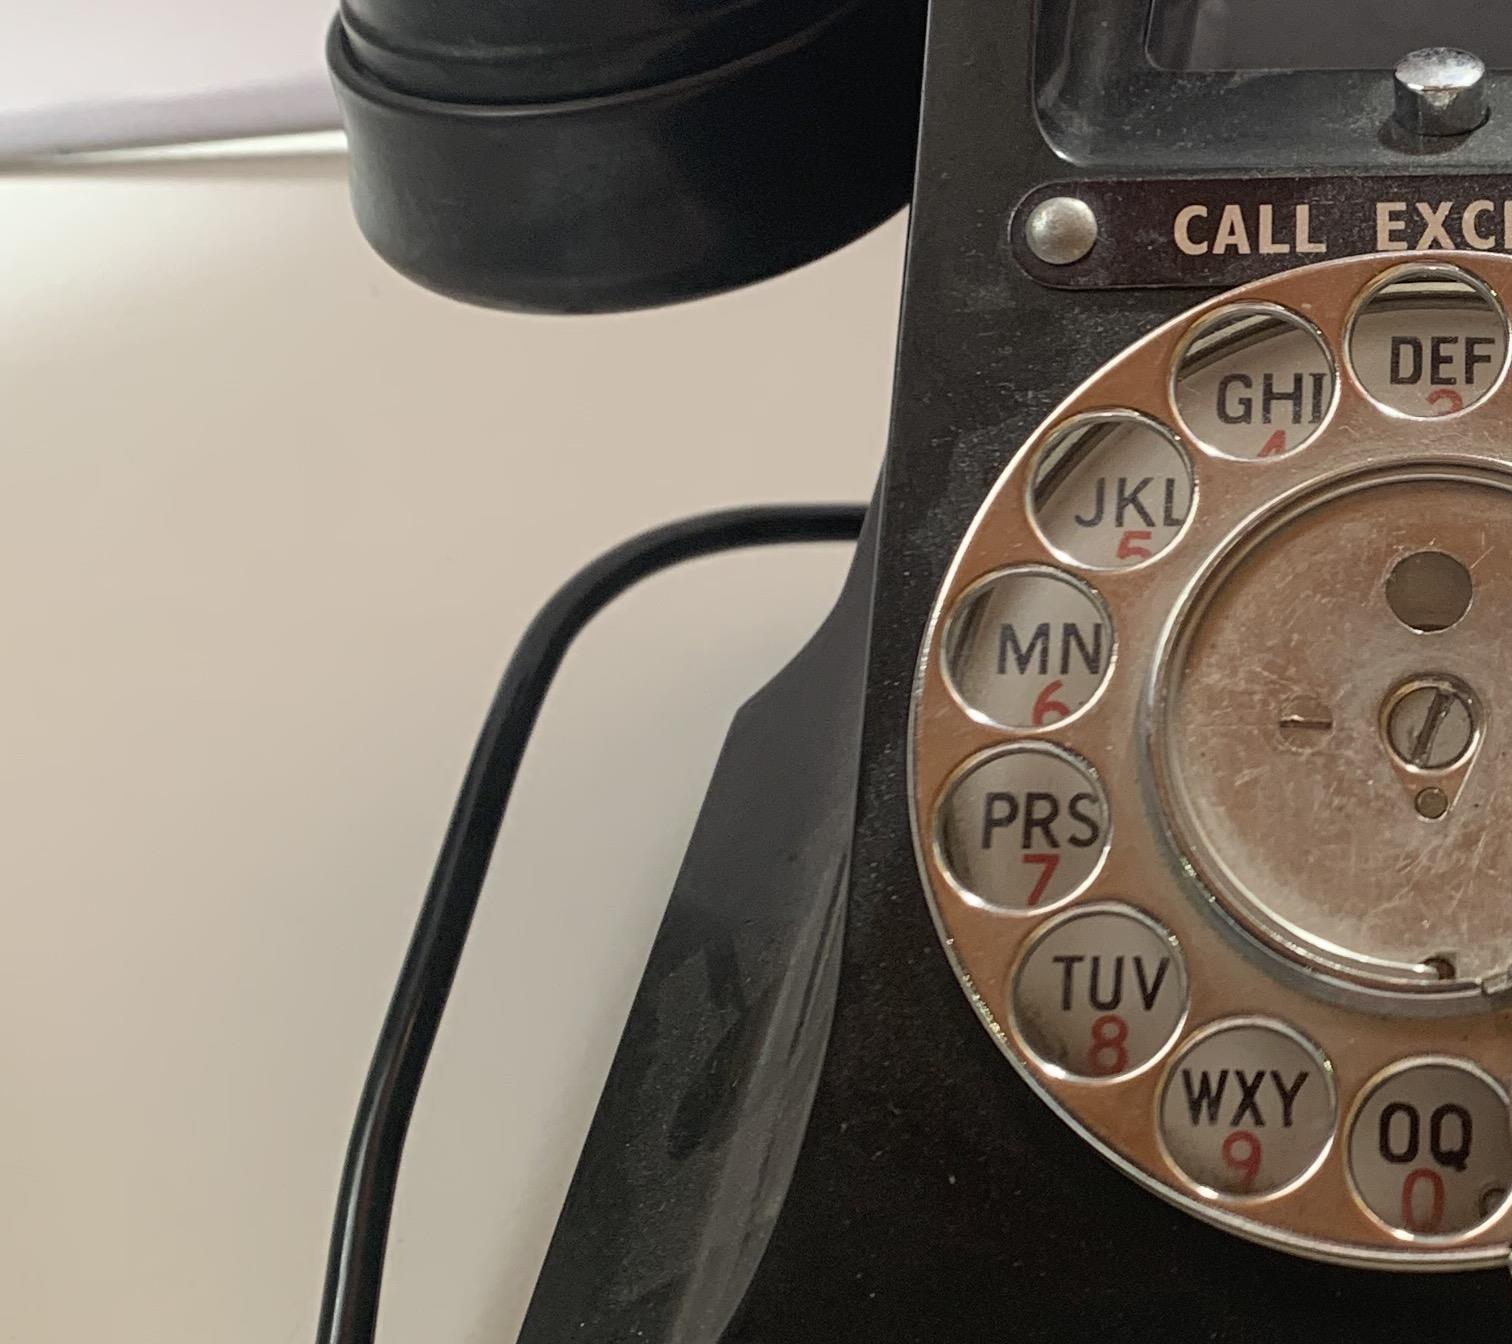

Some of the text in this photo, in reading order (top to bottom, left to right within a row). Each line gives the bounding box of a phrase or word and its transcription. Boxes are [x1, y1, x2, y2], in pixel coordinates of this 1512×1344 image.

[1173, 203, 1327, 255] CALL
[1389, 335, 1496, 386] DEF
[1215, 372, 1328, 425] GHI
[1074, 477, 1187, 528] JKL
[997, 622, 1103, 676] MN
[1031, 679, 1071, 727] 6
[981, 791, 1100, 850] PRS
[1023, 853, 1060, 907] 7
[1052, 955, 1171, 1012] TUV
[1089, 1013, 1130, 1077] 8
[1182, 1069, 1310, 1128] WXY
[1221, 1130, 1262, 1192] 9
